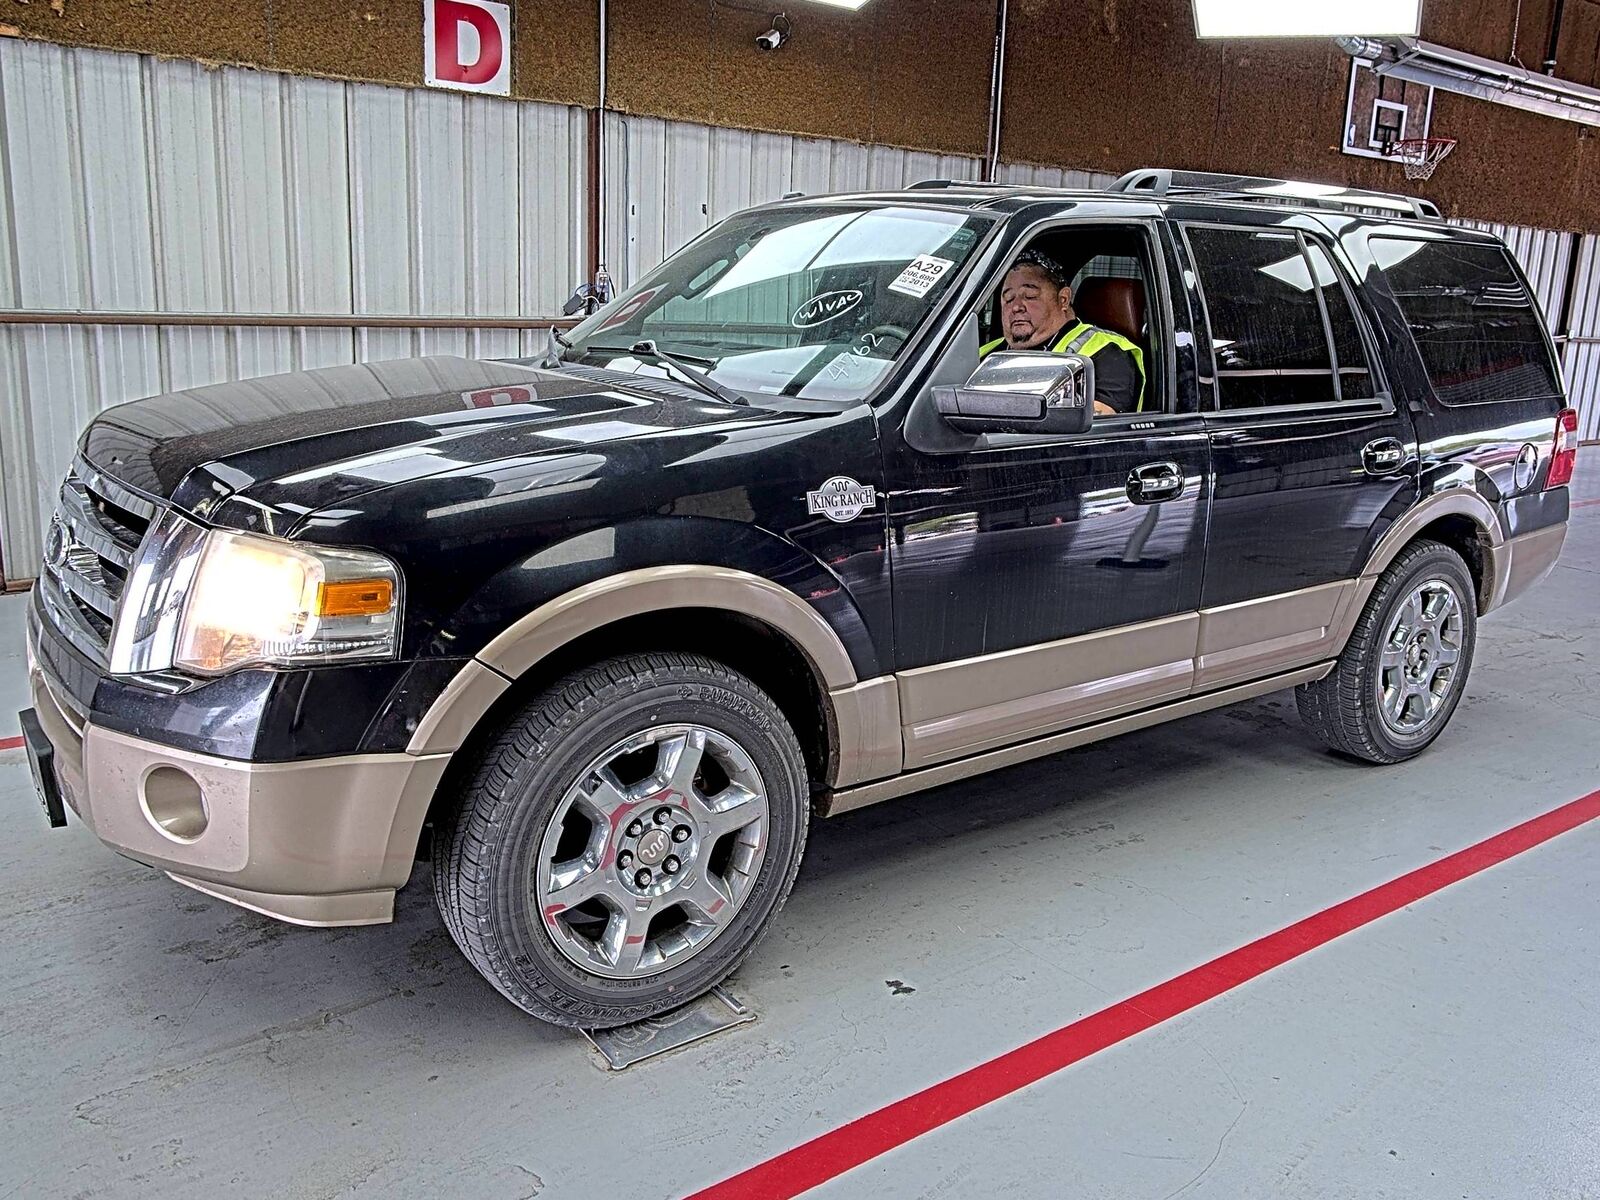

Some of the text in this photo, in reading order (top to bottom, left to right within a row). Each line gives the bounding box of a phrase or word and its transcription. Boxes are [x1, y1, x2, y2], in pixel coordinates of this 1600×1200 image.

[435, 0, 503, 84] D
[909, 260, 943, 275] A29
[908, 278, 930, 288] 2013
[827, 333, 884, 381] 4762
[812, 489, 873, 509] KING RANCH
